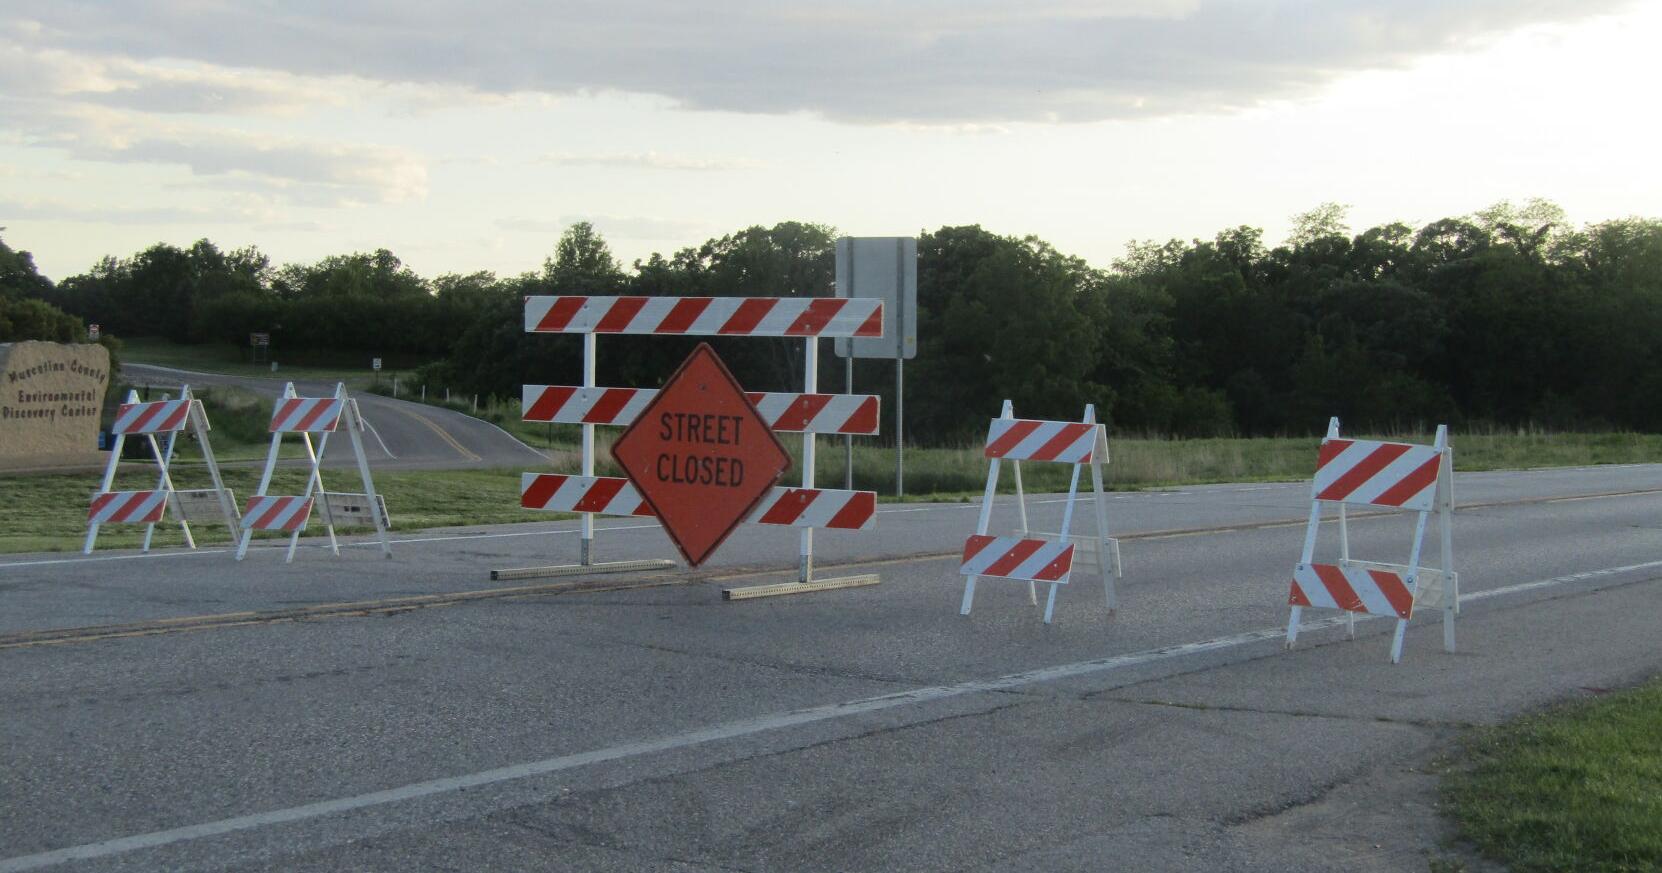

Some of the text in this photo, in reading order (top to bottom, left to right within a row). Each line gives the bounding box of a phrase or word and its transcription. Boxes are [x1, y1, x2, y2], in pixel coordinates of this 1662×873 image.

[8, 359, 106, 384] Muscatine County
[18, 388, 96, 403] Environmental
[2, 404, 97, 422] Discovery Center
[659, 412, 744, 445] STREET
[656, 453, 744, 487] CLOSED
